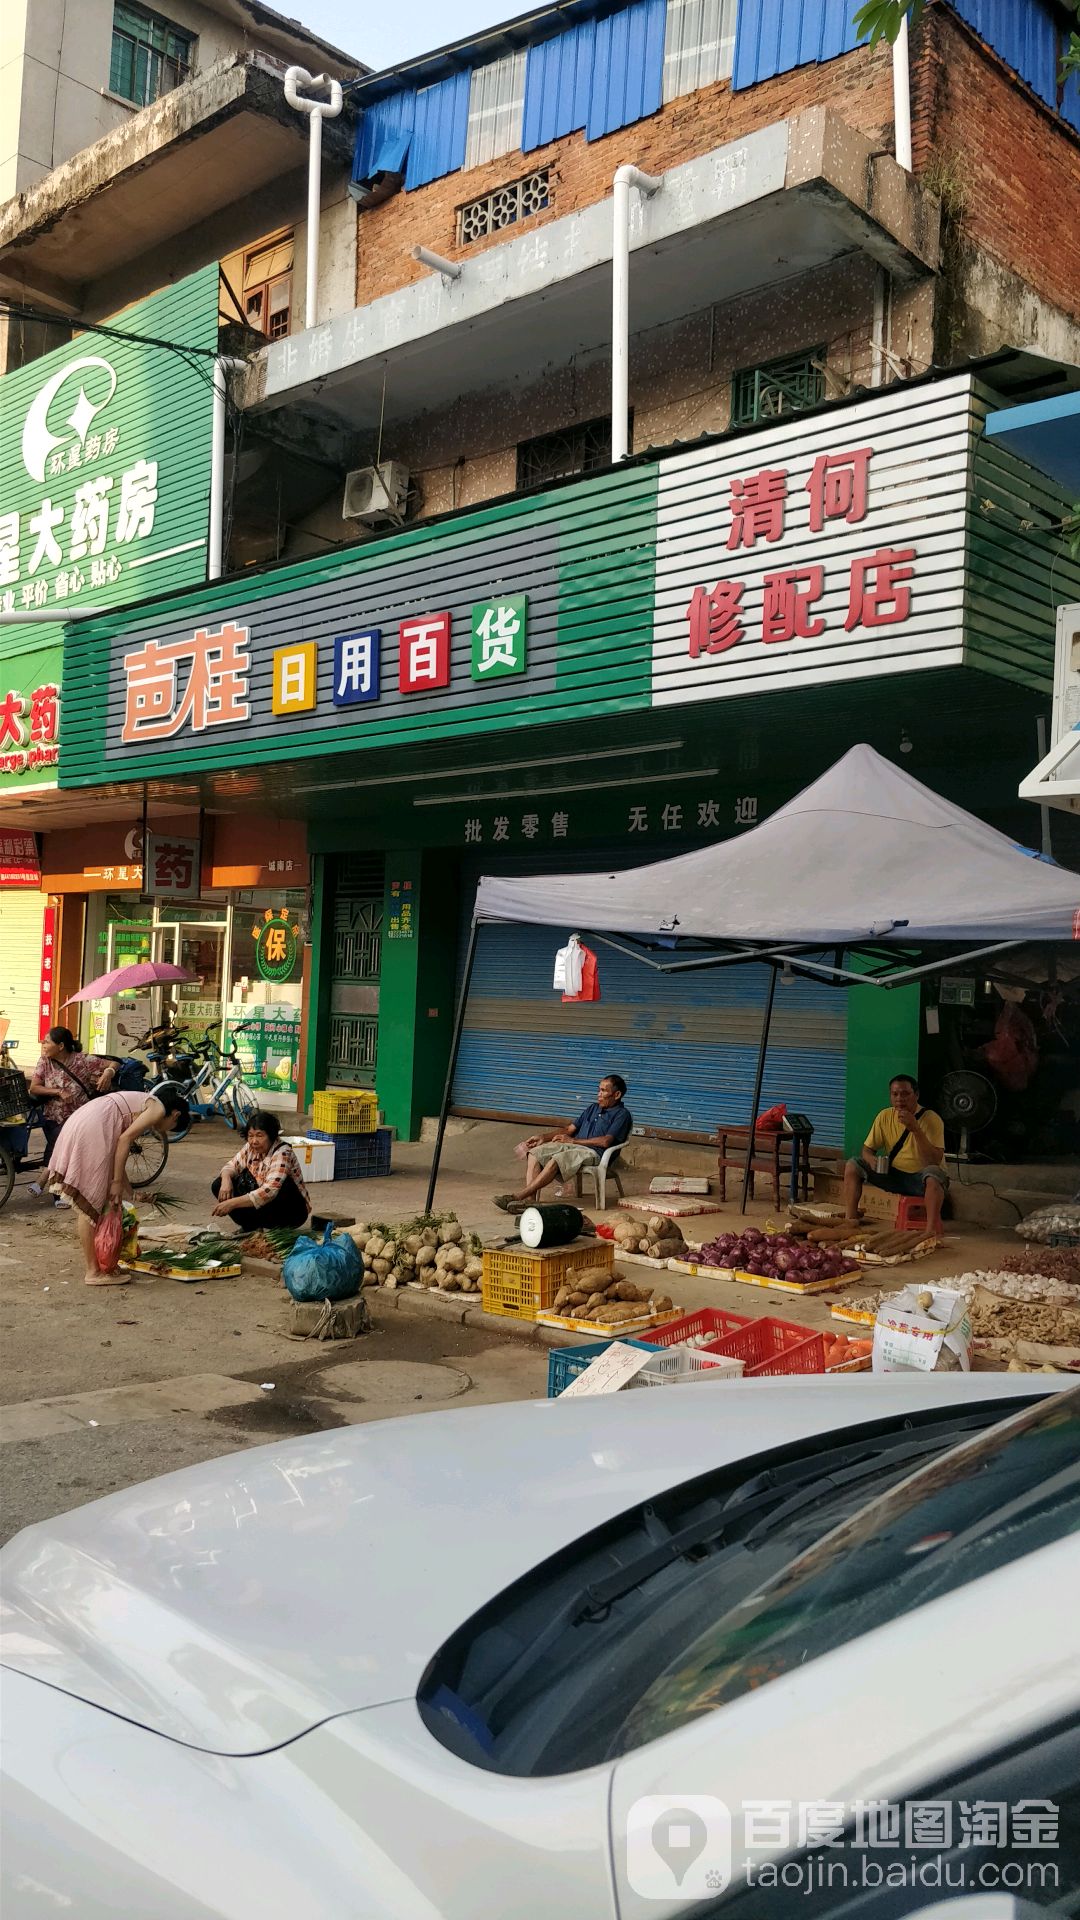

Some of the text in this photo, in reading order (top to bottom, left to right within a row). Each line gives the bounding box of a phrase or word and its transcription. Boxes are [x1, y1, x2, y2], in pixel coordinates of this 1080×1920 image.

[50, 427, 120, 475] 环星药房
[726, 447, 874, 550] 清何
[22, 579, 48, 609] 平价
[55, 566, 85, 599] 省心
[91, 555, 122, 588] 贴心
[686, 548, 917, 658] 修配店
[464, 797, 758, 843] 批发零售 无任欢迎
[103, 866, 143, 881] 环星大
[154, 843, 194, 889] 药
[268, 860, 294, 872] 城南店
[266, 927, 287, 961] 保
[182, 1002, 221, 1017] 环星大药房
